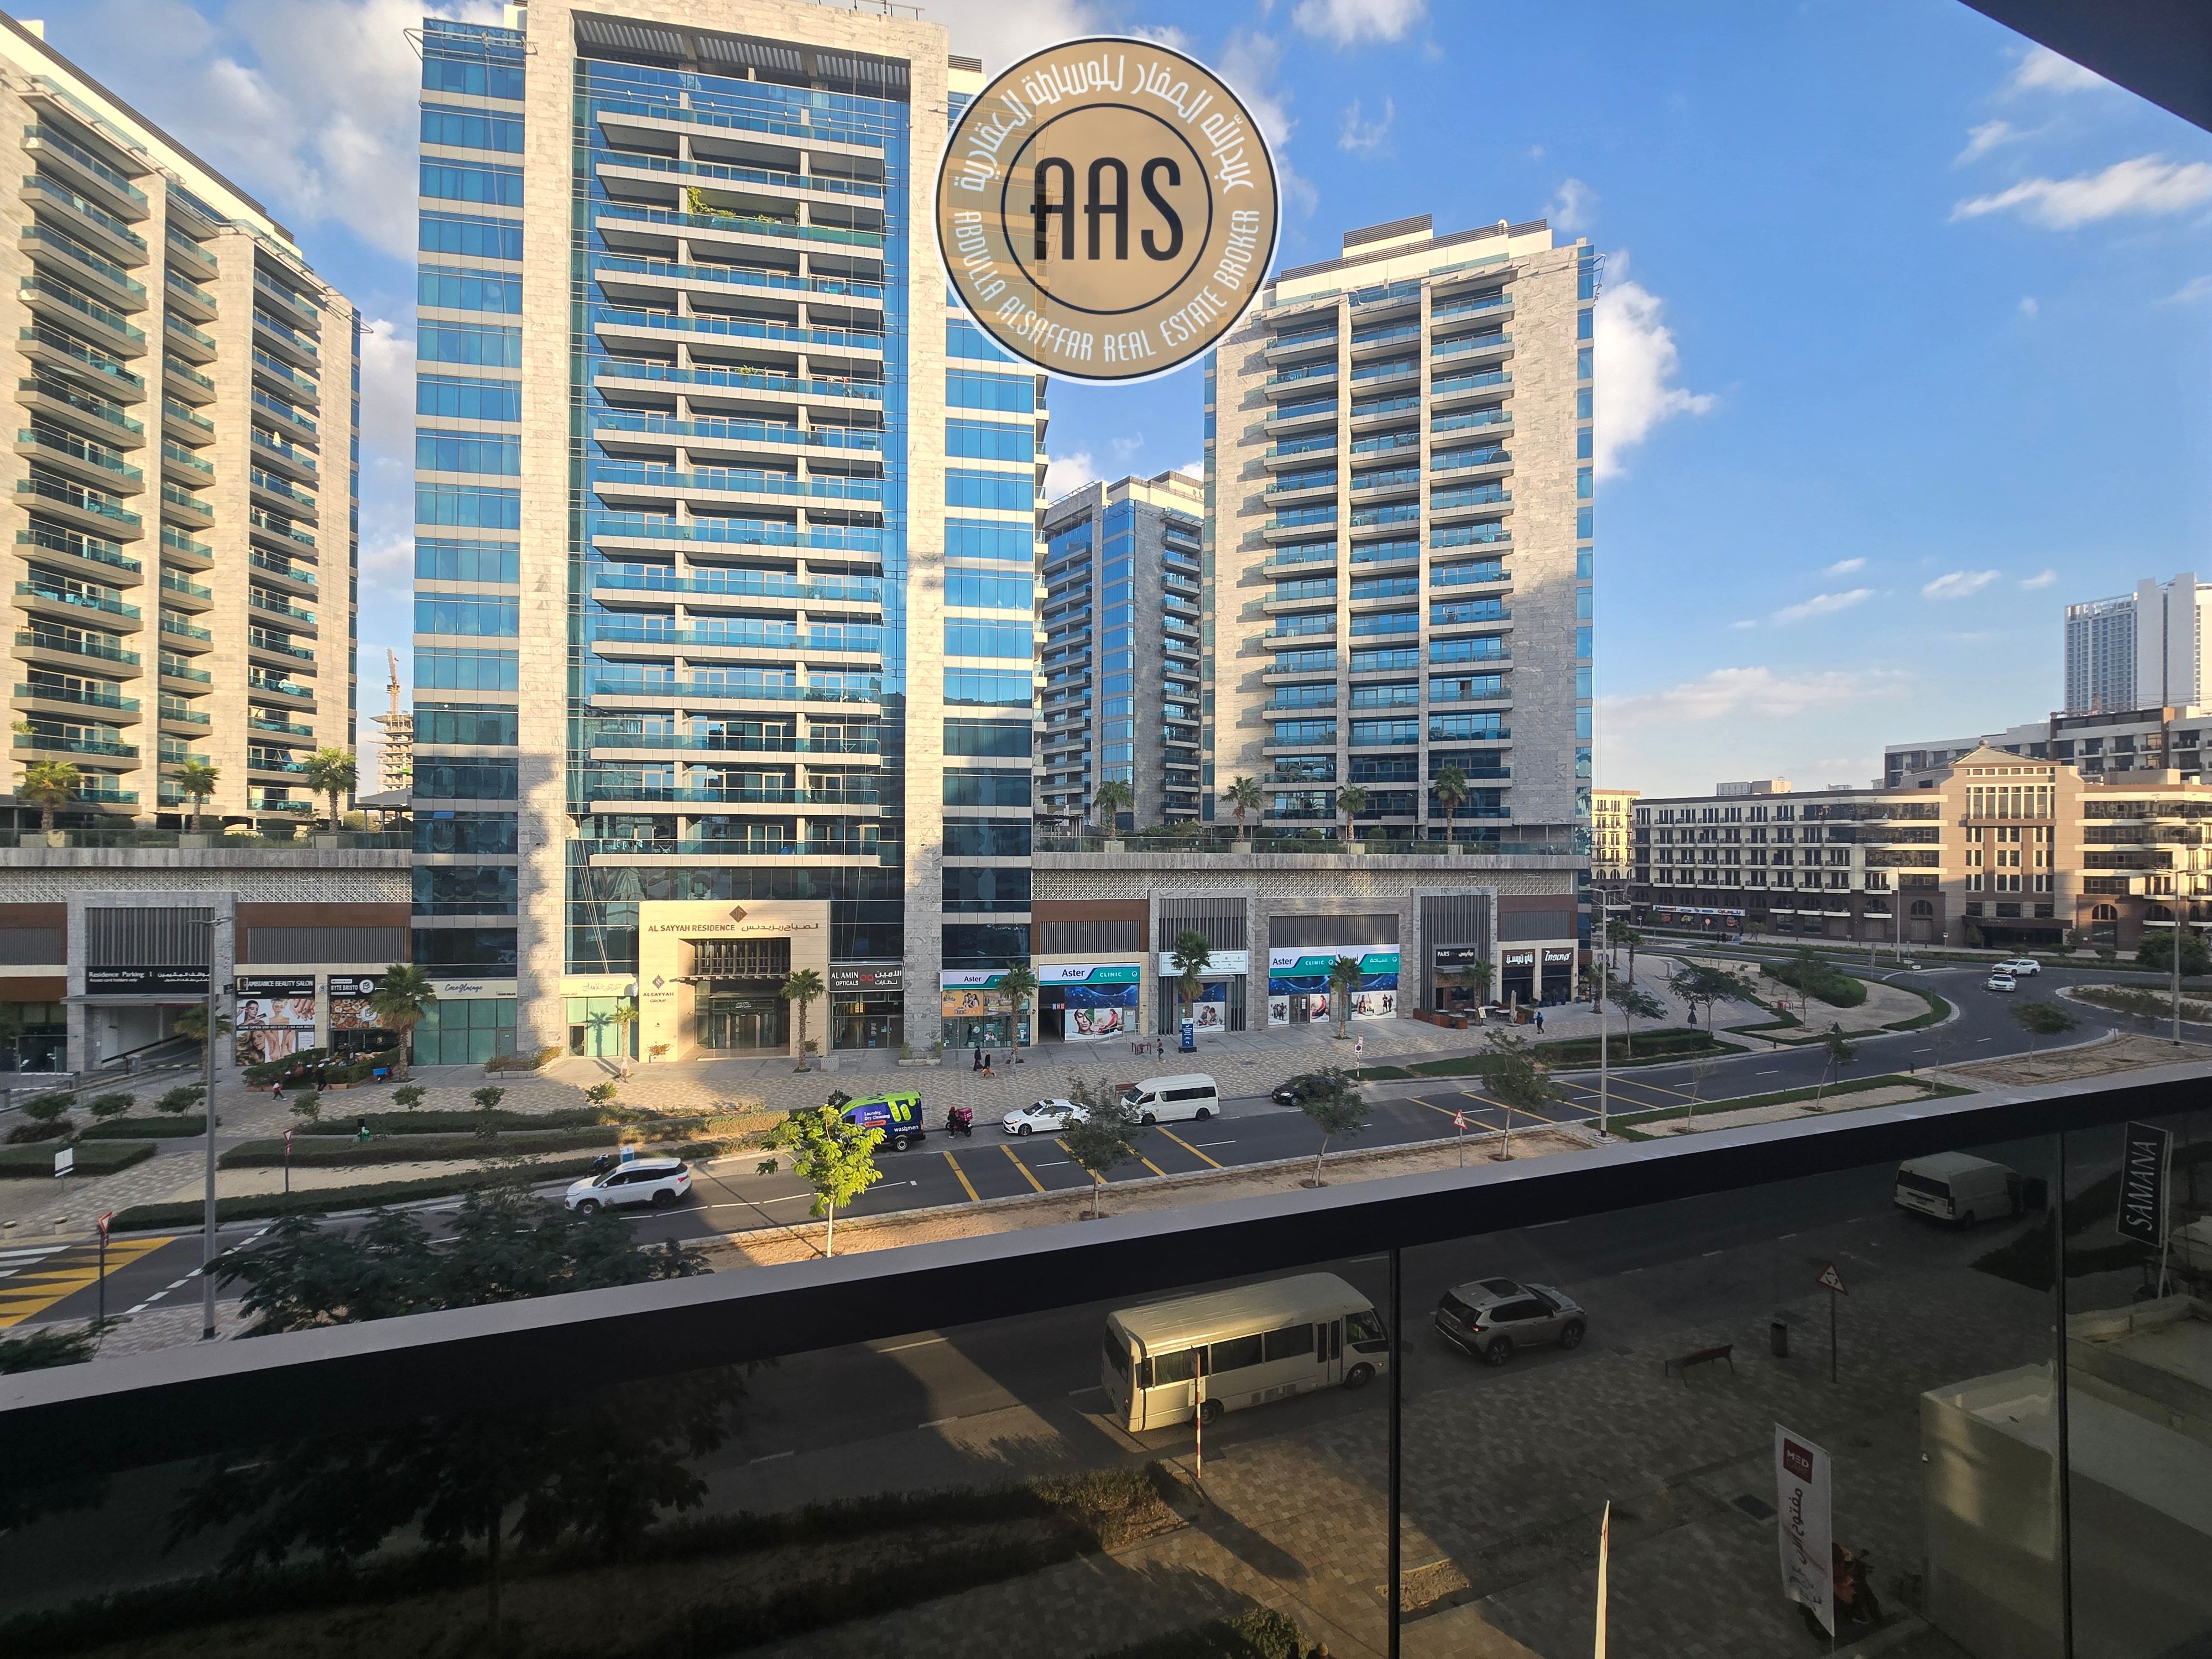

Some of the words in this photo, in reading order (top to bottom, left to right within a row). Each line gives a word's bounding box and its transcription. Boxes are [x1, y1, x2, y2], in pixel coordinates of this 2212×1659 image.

[1062, 969, 1086, 977] Aster
[2126, 1141, 2157, 1231] SAMANA
[1787, 1449, 1809, 1468] MED
